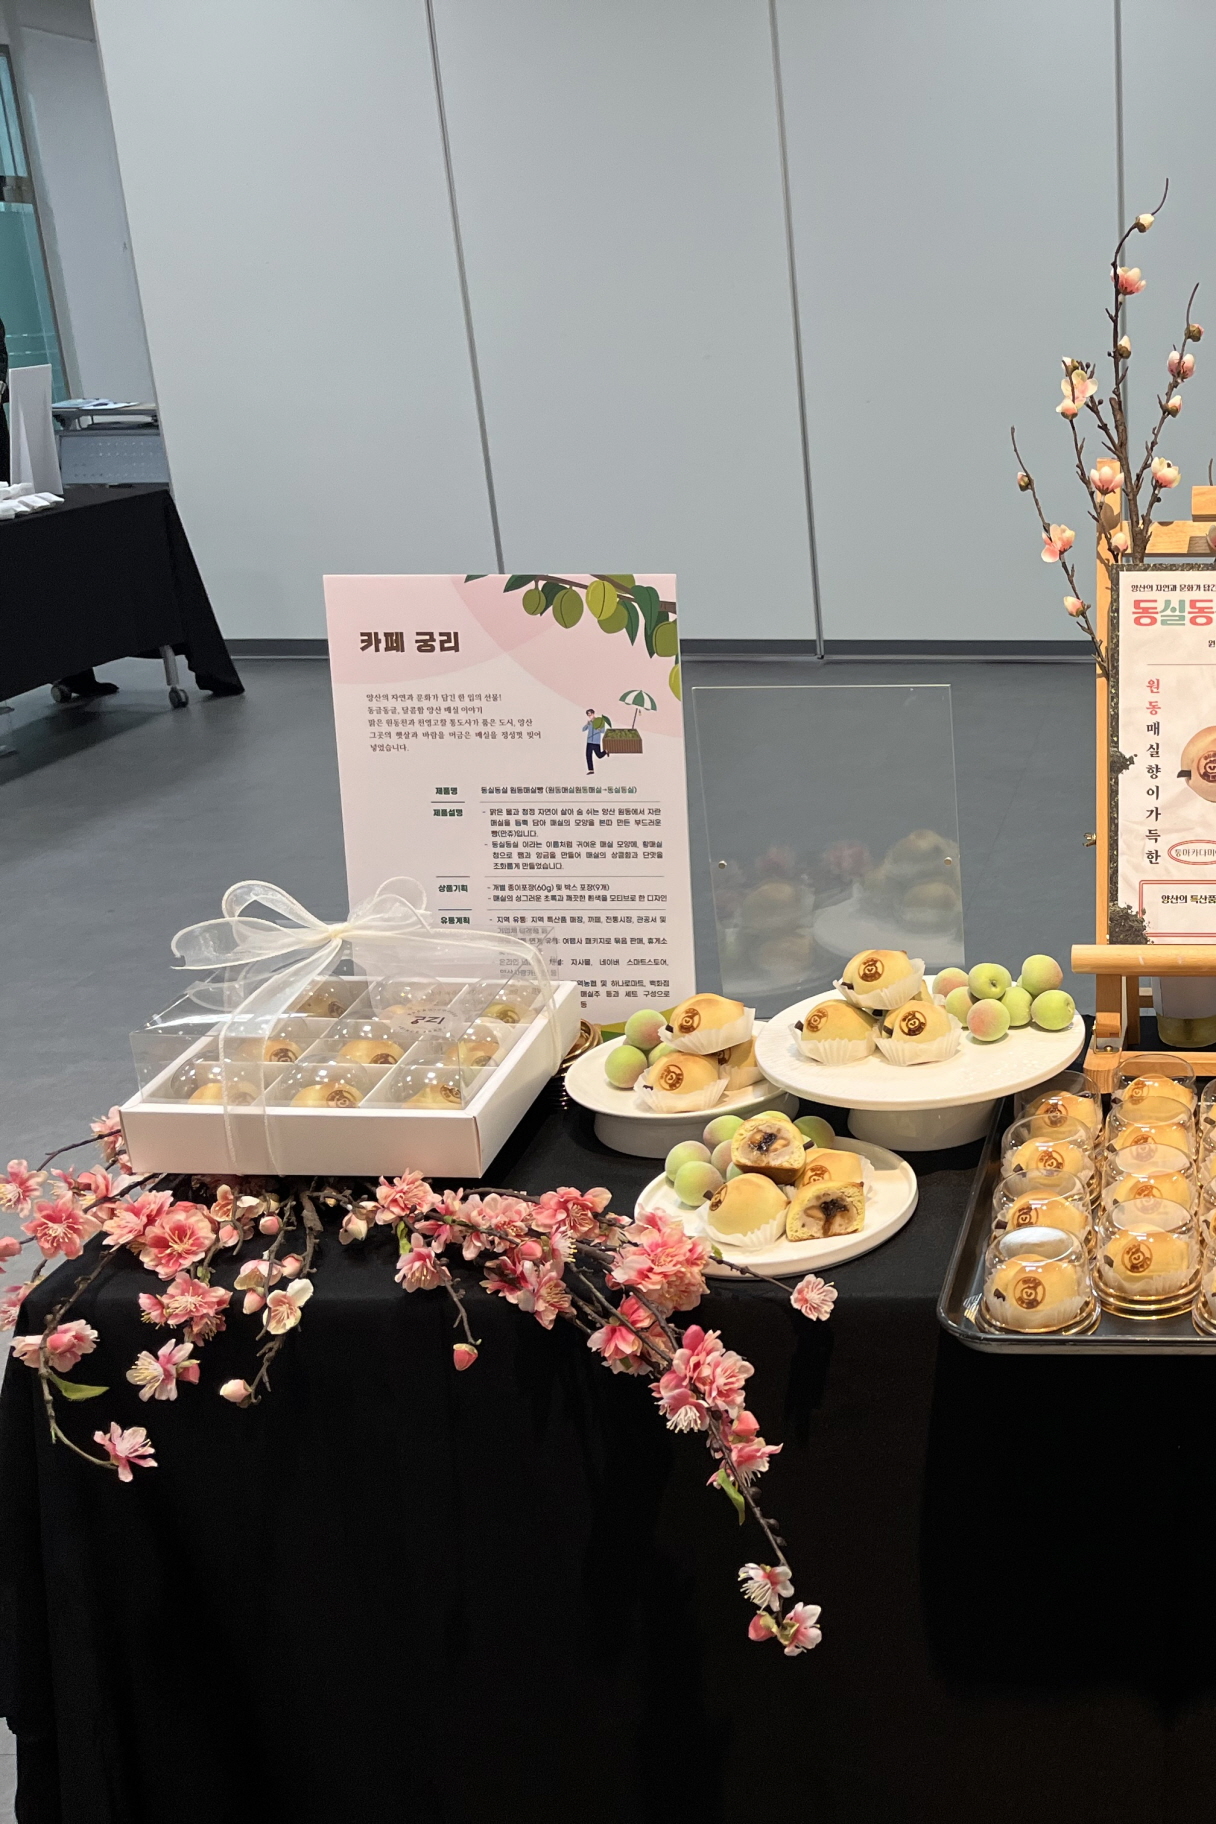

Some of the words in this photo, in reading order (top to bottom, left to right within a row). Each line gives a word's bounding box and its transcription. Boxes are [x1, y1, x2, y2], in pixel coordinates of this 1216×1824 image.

[1131, 583, 1153, 593] 양산의
[1155, 583, 1177, 593] 자연과
[1179, 583, 1201, 593] 문화가
[360, 631, 405, 653] 카페
[415, 631, 460, 653] 궁리
[366, 692, 389, 703] 양산의
[391, 692, 414, 703] 자연과
[416, 692, 439, 703] 문화가
[435, 786, 458, 796] 제품명
[481, 785, 508, 795] 동실동실
[433, 808, 463, 818] 제품설명
[550, 818, 570, 828] 매실의
[492, 839, 519, 849] 동실동실
[586, 850, 606, 860] 매실의
[438, 883, 468, 894] 상품기획
[493, 894, 513, 903] 매실의
[1161, 894, 1188, 905] 양산의
[440, 915, 470, 926] 유통계획
[577, 979, 597, 988] 역농협
